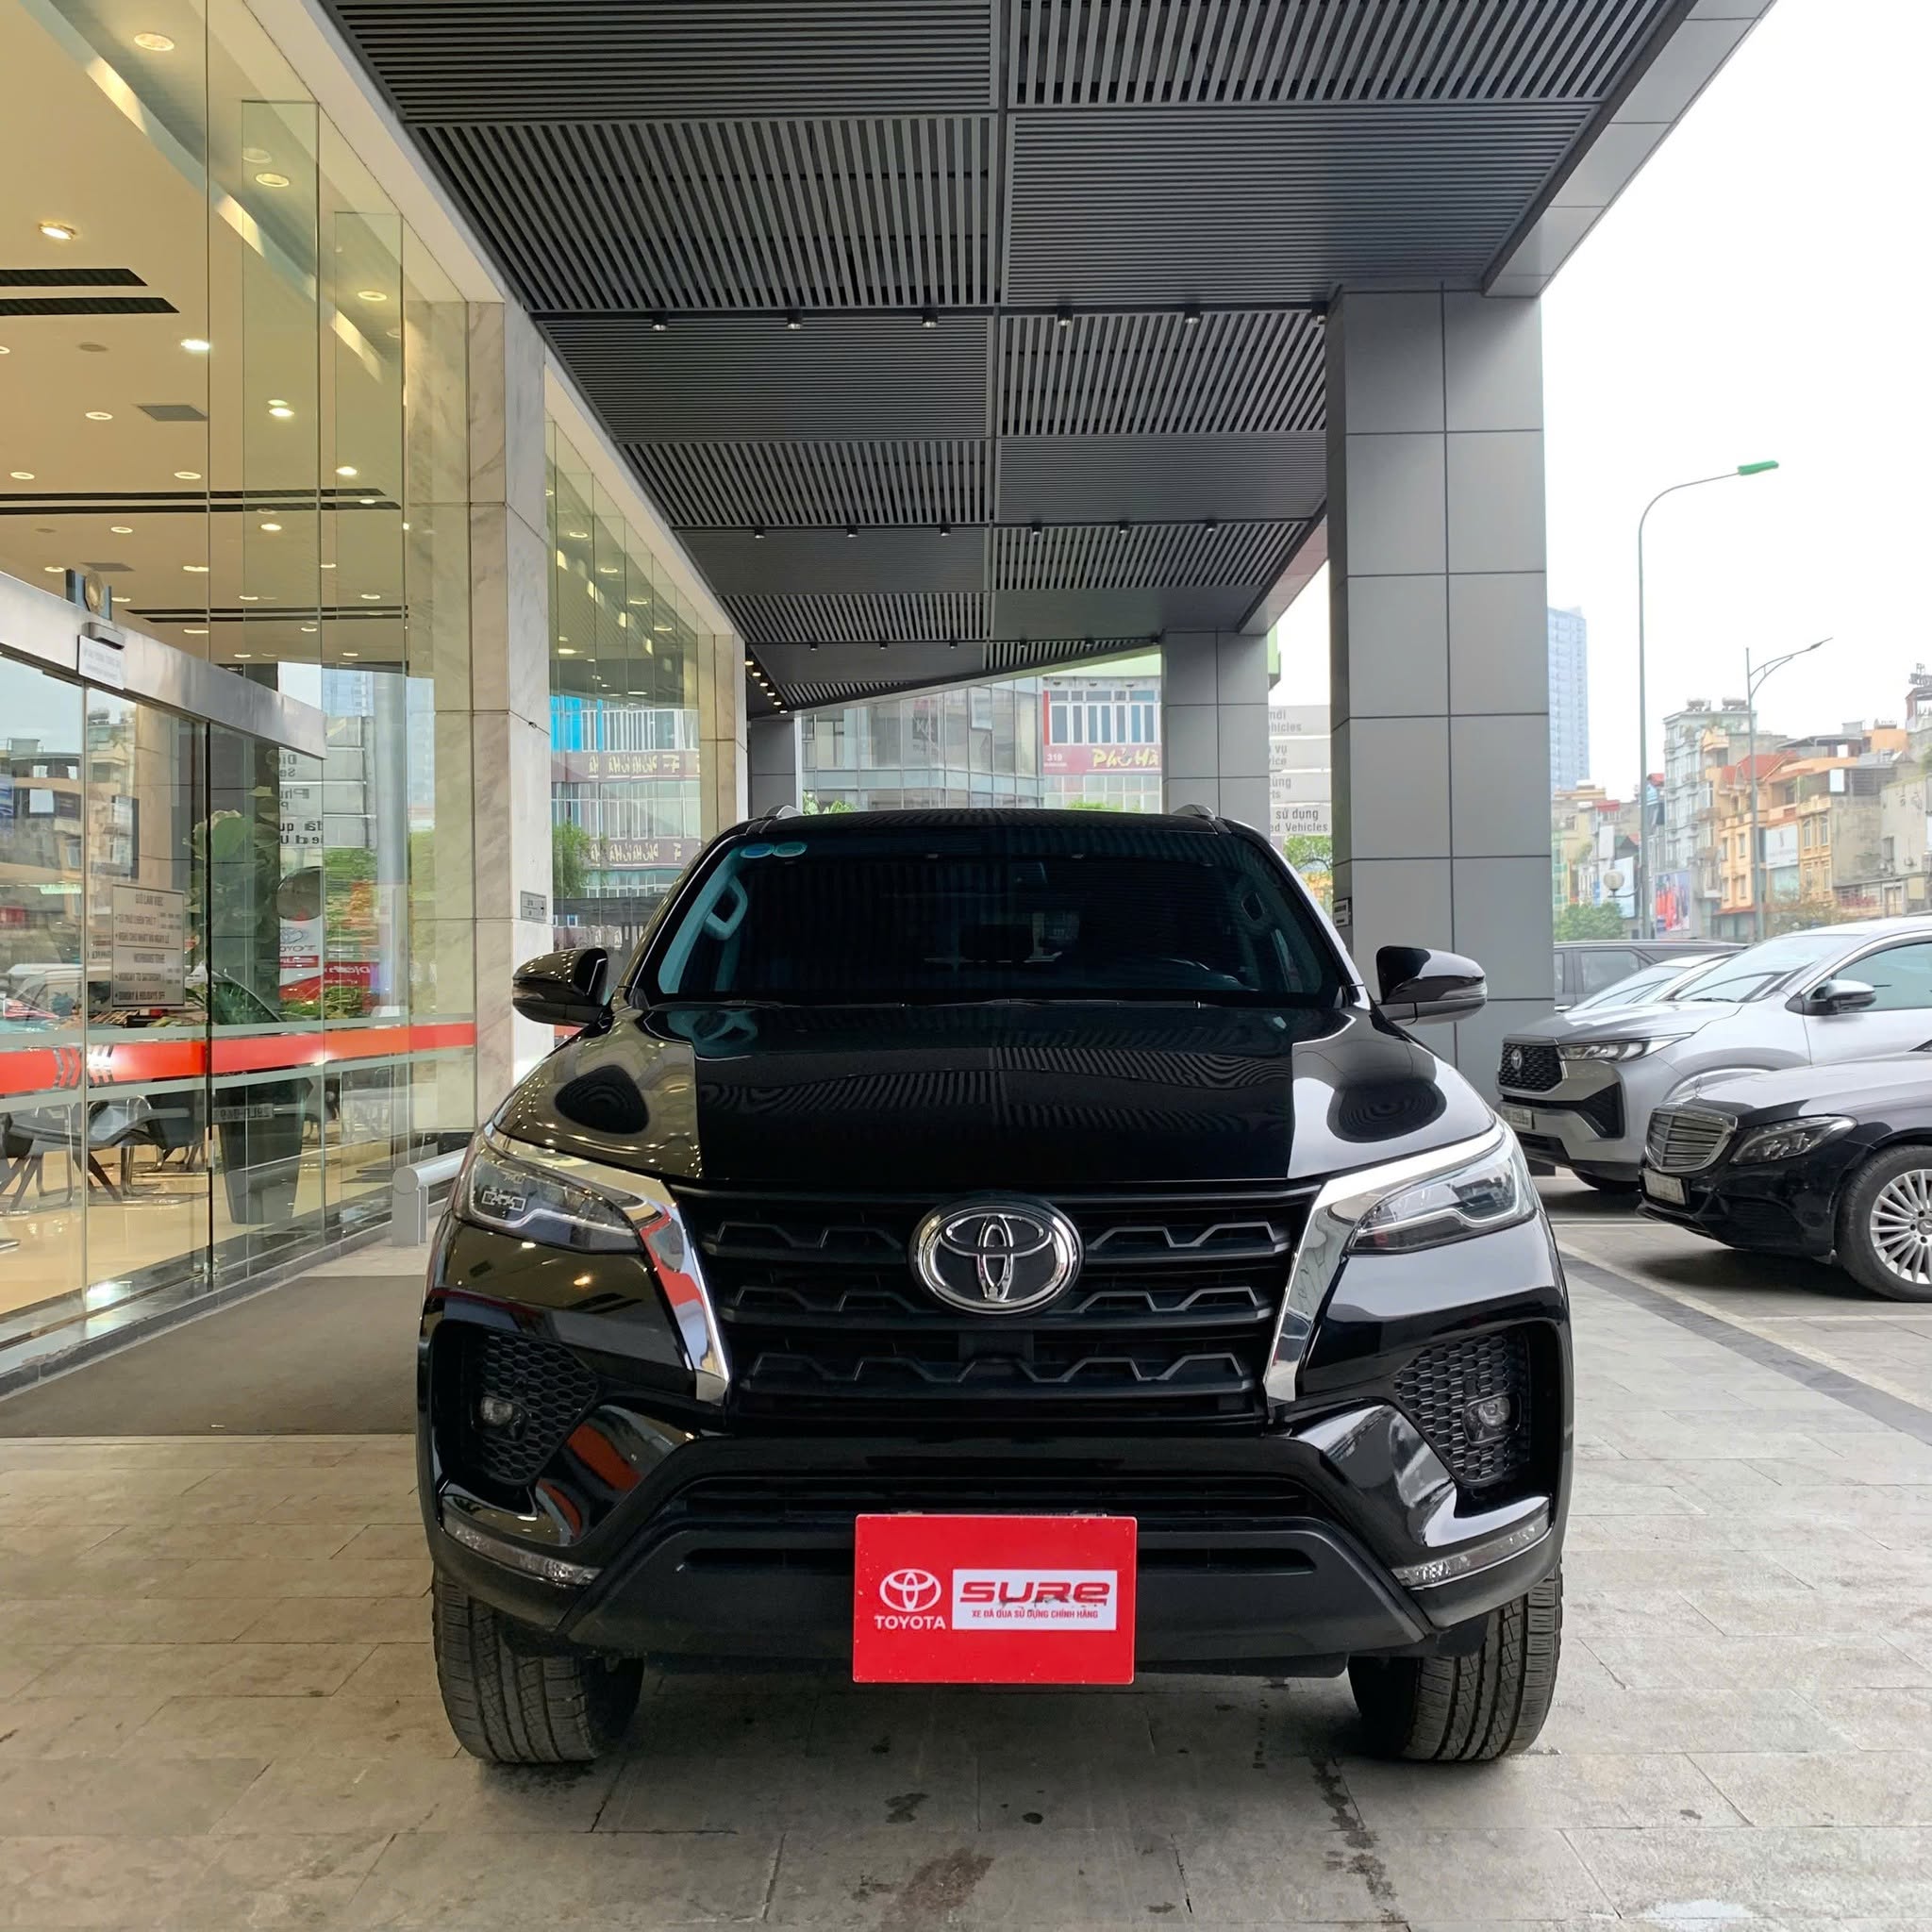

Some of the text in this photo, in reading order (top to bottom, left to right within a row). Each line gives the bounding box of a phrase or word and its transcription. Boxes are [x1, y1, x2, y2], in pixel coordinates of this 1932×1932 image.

[1269, 722, 1302, 733] hicles
[1285, 823, 1328, 832] Vehicles
[972, 1609, 982, 1618] XE
[996, 1609, 1012, 1619] QUA
[874, 1615, 946, 1630] TOYOTA
